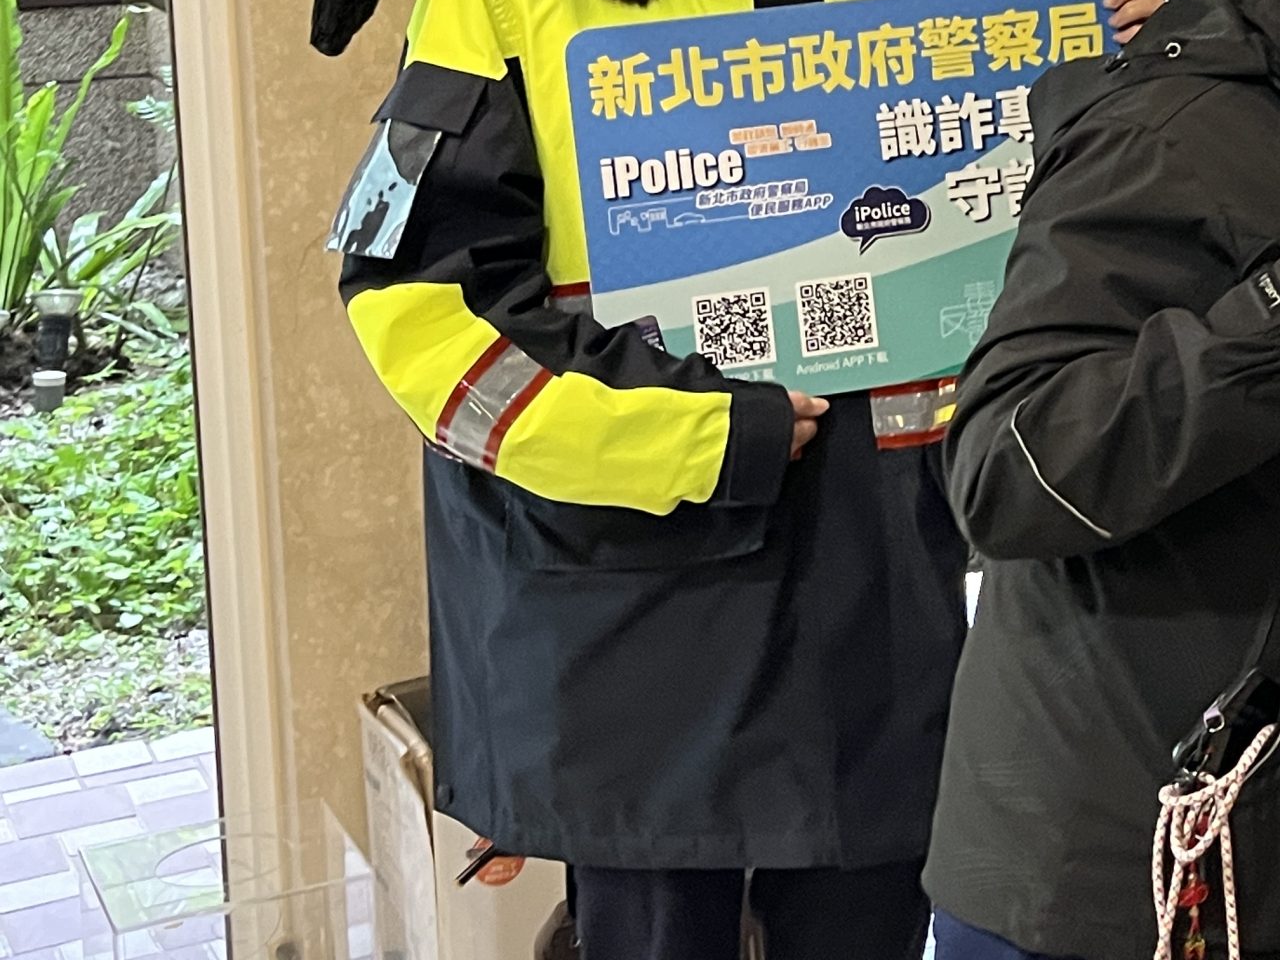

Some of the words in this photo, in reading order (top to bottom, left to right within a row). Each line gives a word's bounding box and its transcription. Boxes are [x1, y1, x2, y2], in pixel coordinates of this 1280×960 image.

[588, 2, 1104, 120] 新北市政府警察局
[600, 148, 744, 200] iPolice
[697, 180, 807, 208] 新北市政府警察局
[855, 202, 911, 222] iPolice
[796, 359, 840, 375] Android
